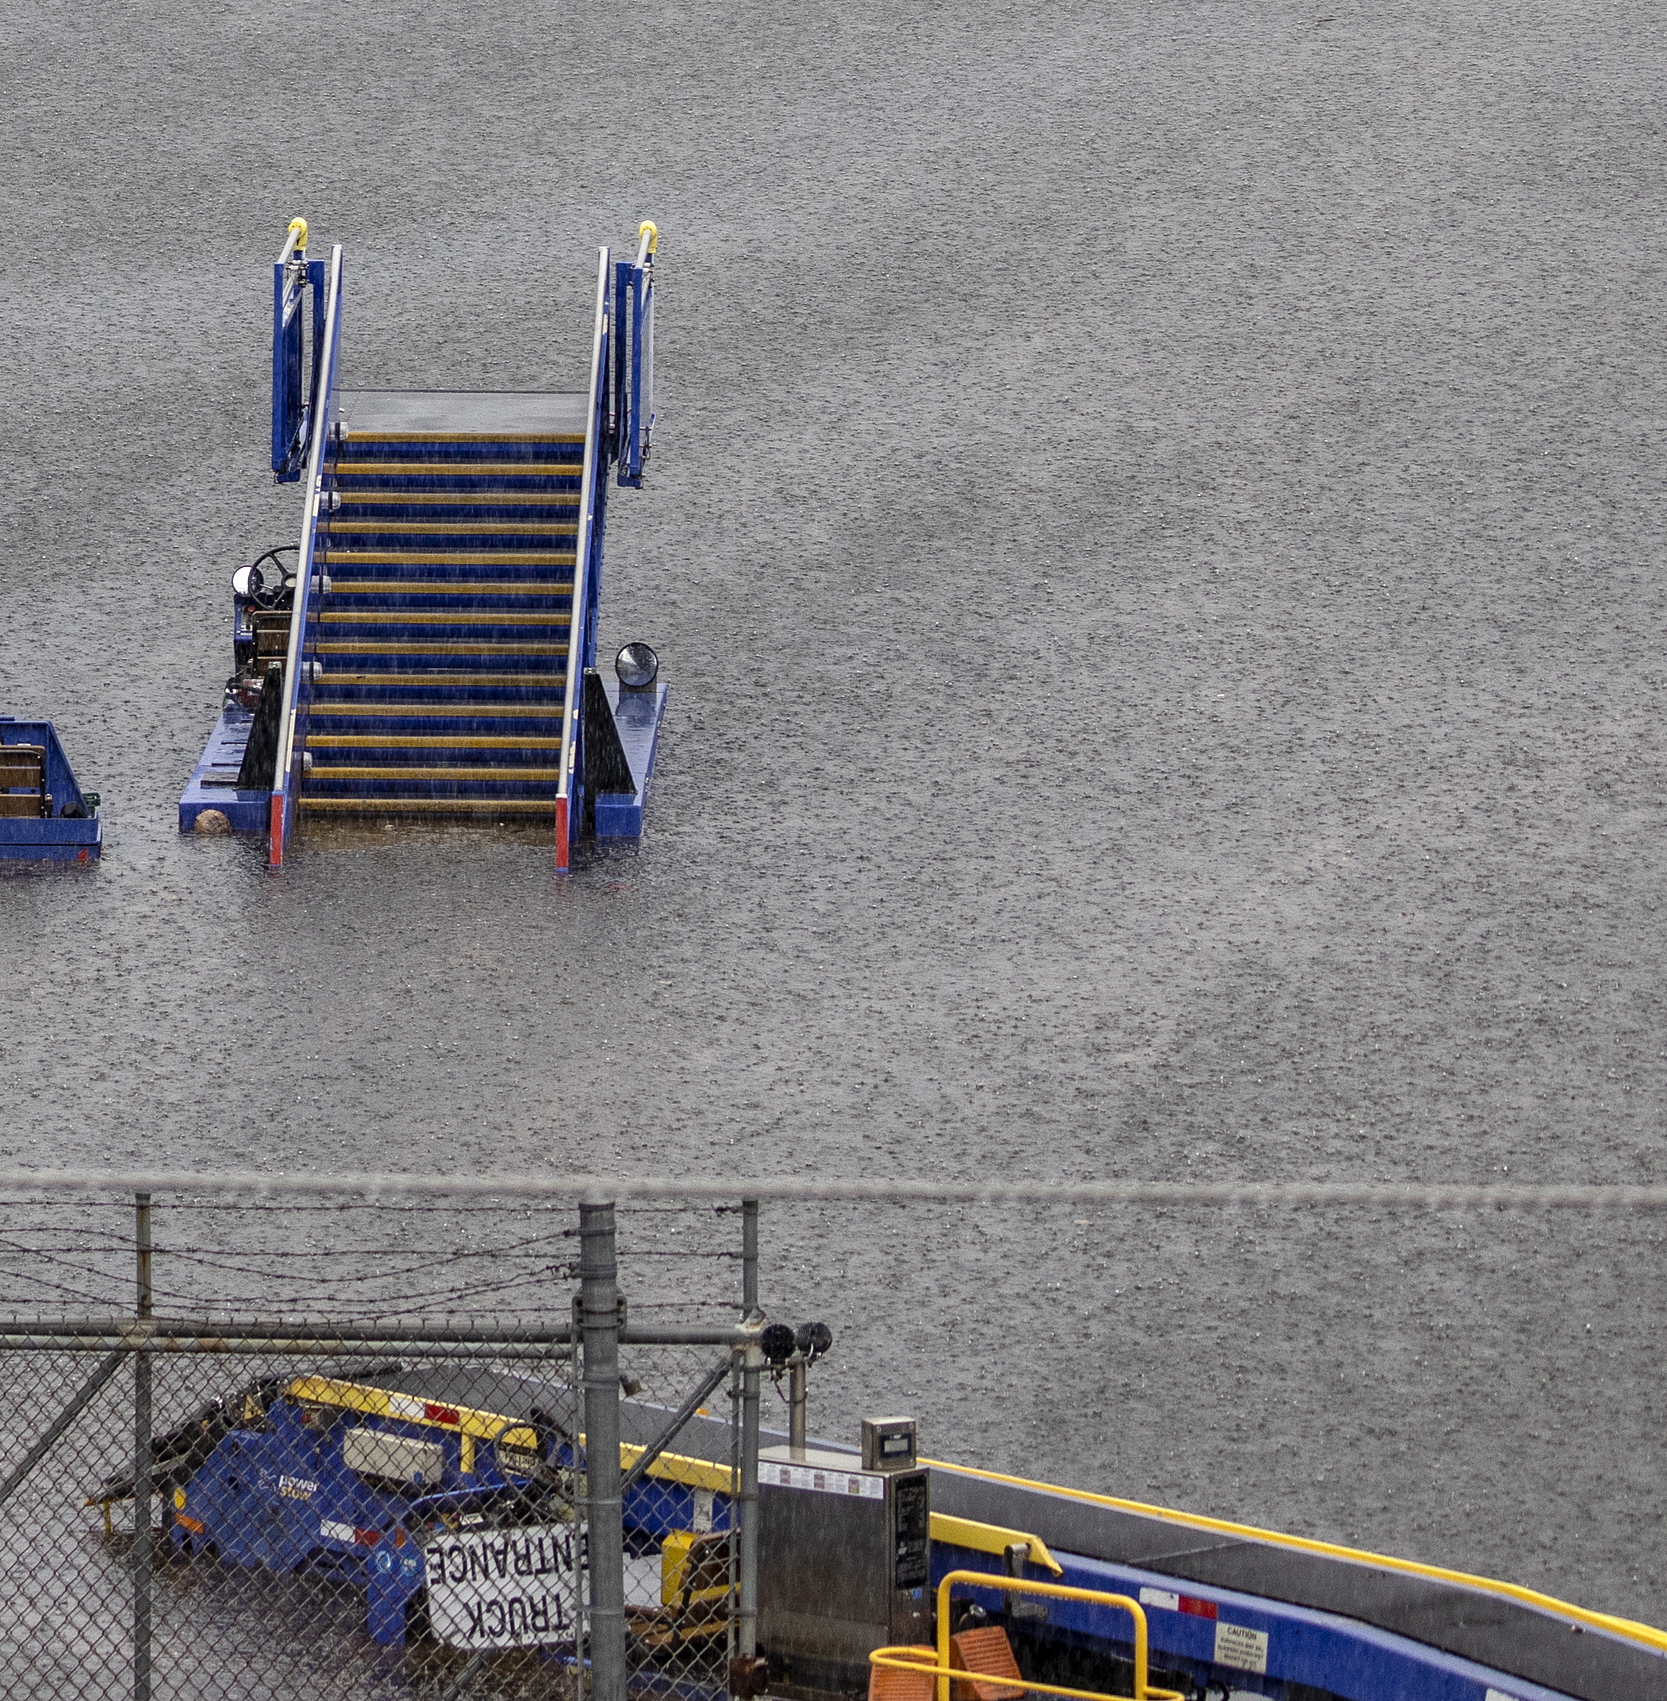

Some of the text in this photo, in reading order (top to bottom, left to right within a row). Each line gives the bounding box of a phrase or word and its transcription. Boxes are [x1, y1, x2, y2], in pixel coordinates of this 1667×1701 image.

[279, 1474, 319, 1492] power
[280, 1486, 312, 1500] stow
[463, 1593, 570, 1639] TRUCK
